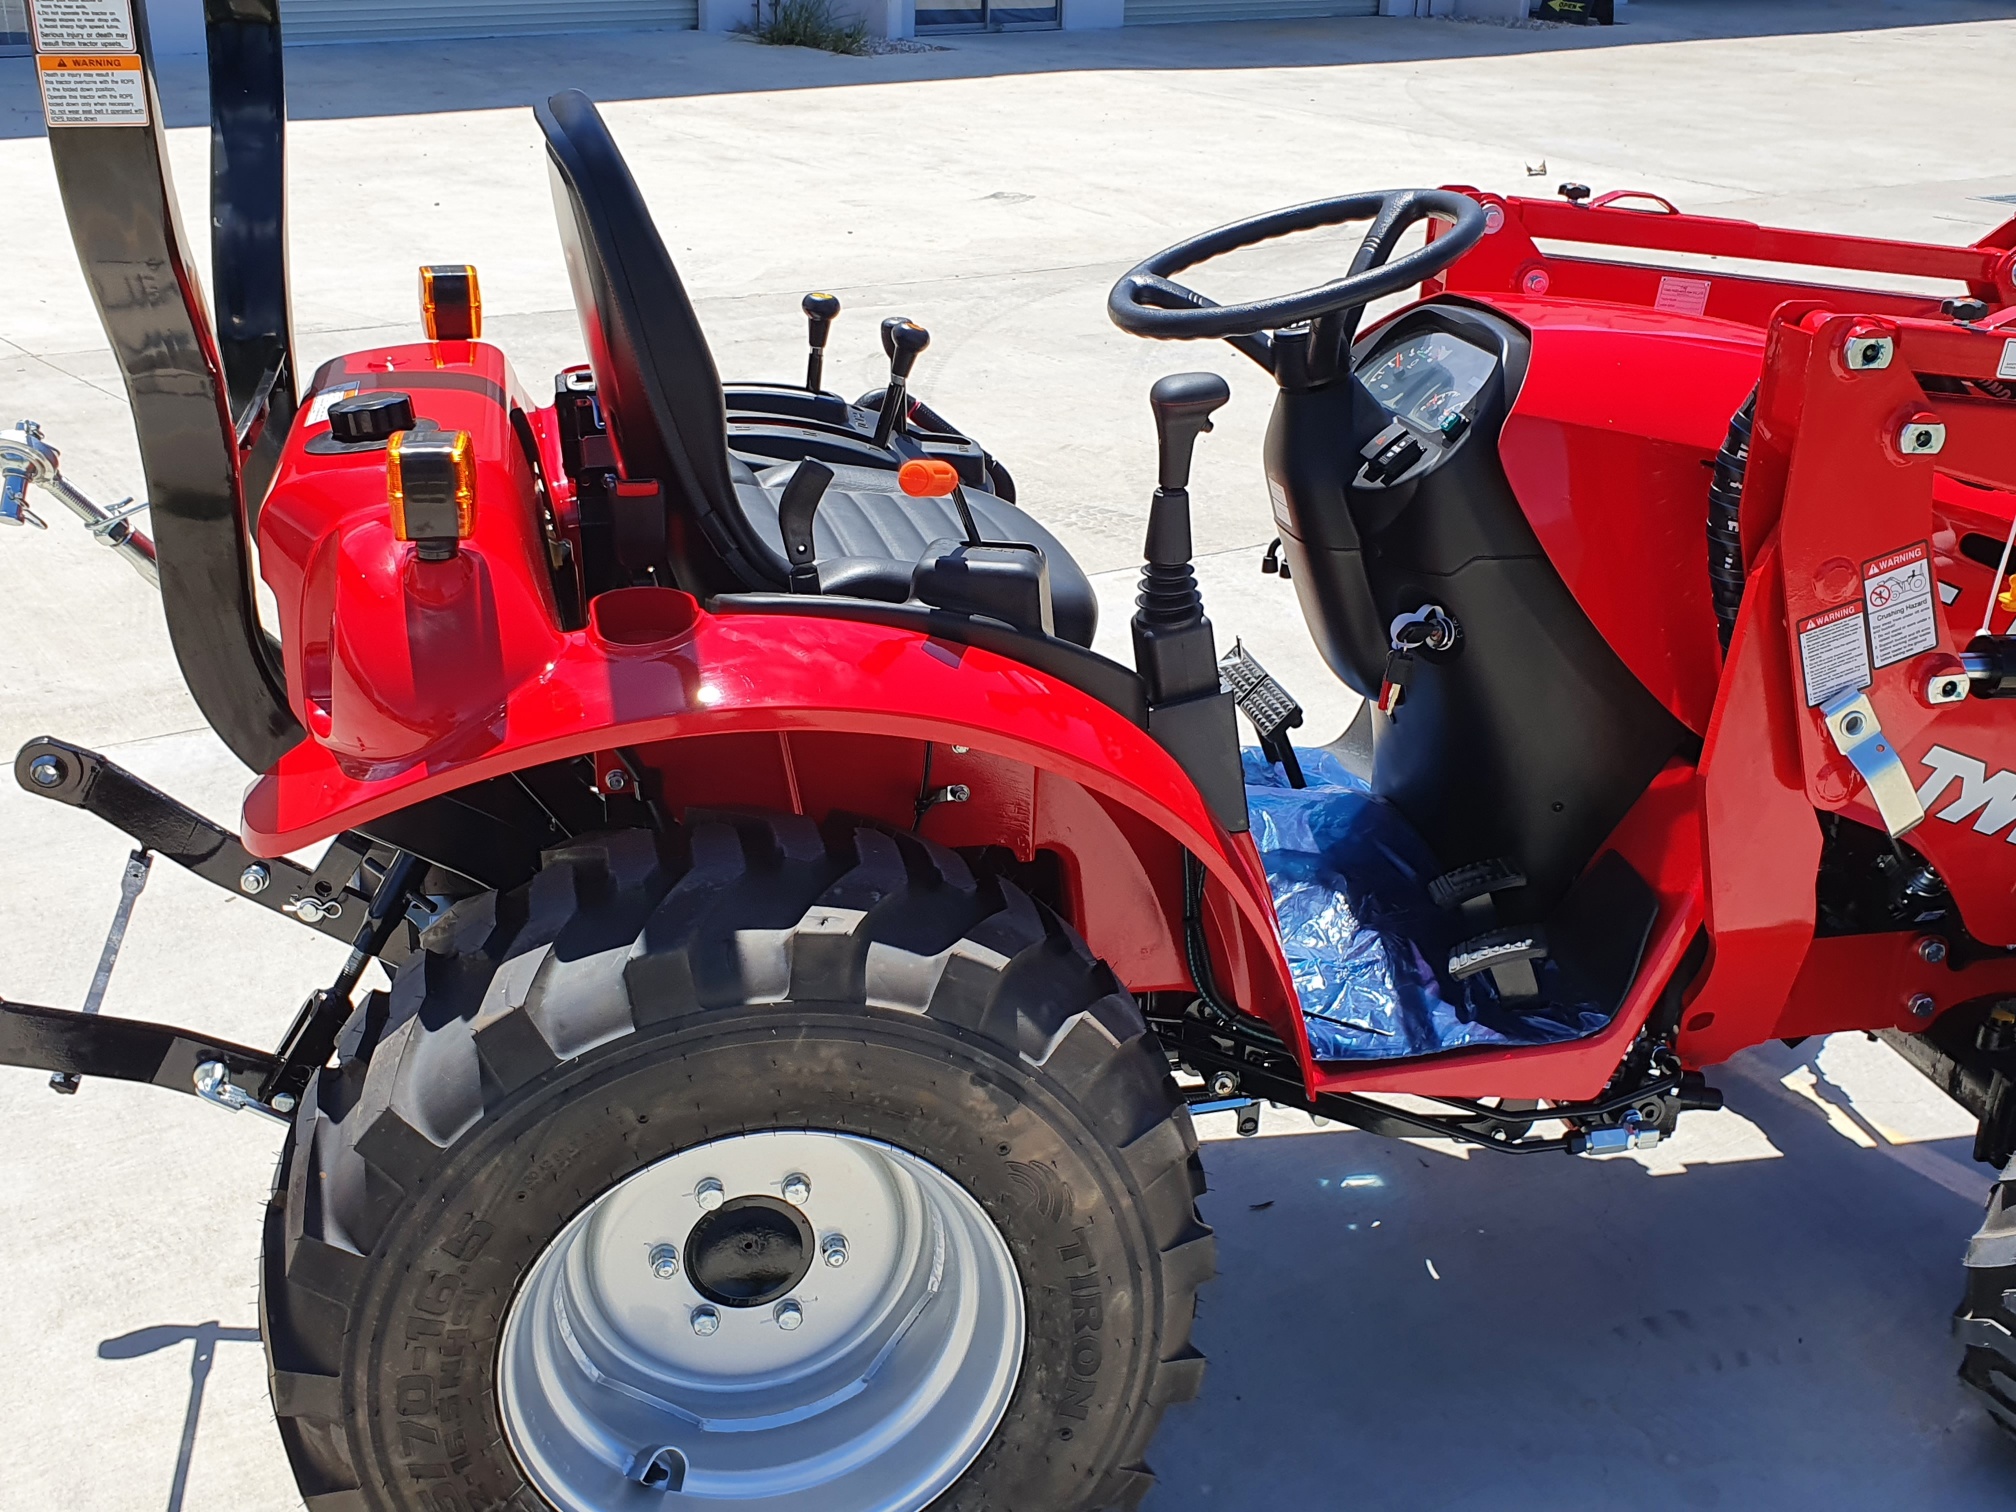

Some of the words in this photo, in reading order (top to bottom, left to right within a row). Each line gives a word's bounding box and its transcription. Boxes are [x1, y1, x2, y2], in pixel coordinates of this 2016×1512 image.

[1878, 548, 1922, 569] WARNING
[1816, 606, 1854, 626] WARNING
[1877, 608, 1904, 621] Crushing
[1906, 598, 1927, 610] Hazard
[1057, 1225, 1103, 1420] TIRON
